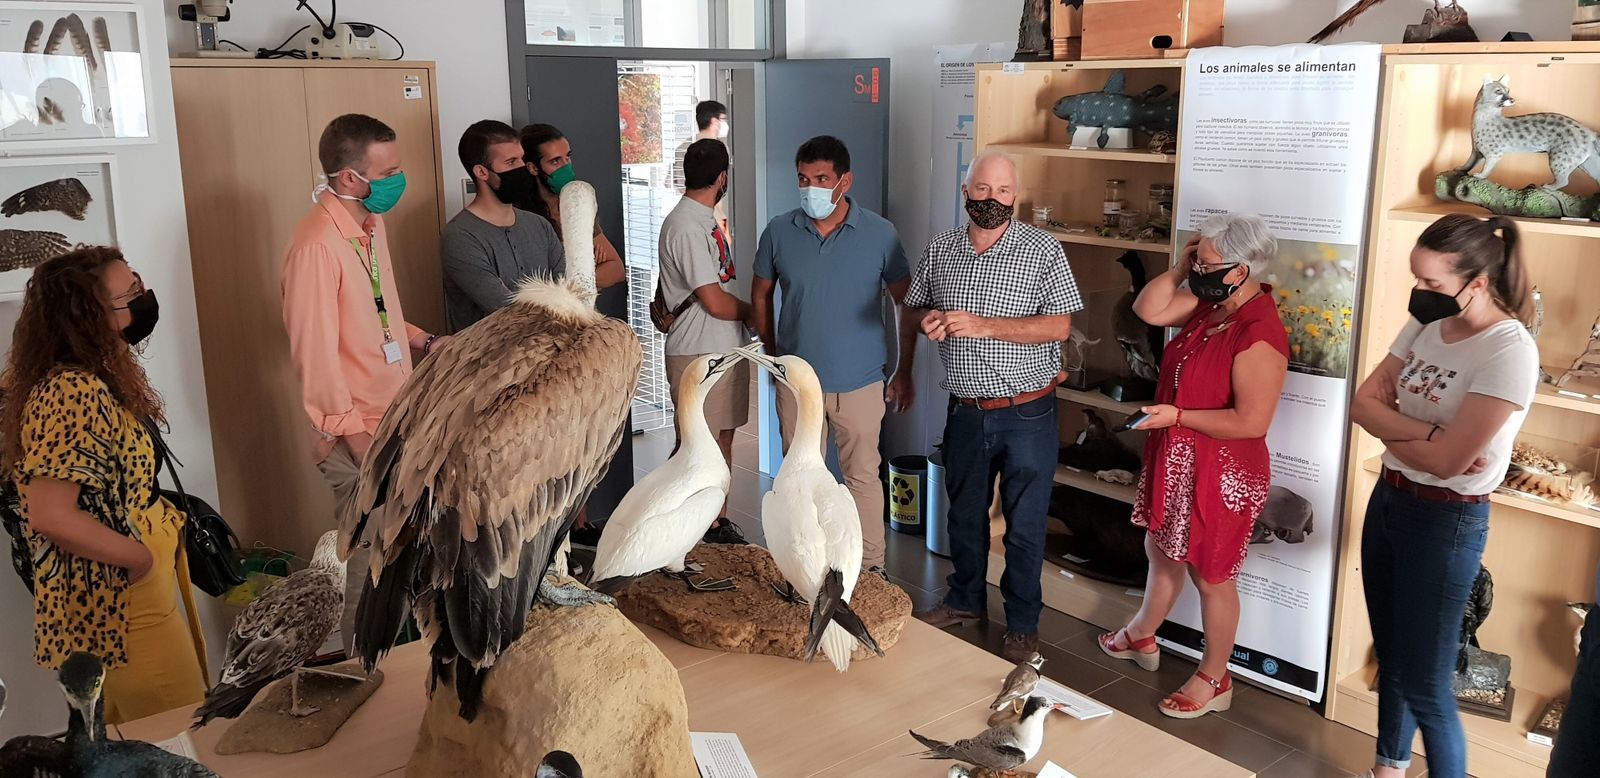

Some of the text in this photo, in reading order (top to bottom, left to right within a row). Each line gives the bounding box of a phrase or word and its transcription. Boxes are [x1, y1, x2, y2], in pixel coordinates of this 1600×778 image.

[1199, 61, 1356, 74] Los animales se alimentan
